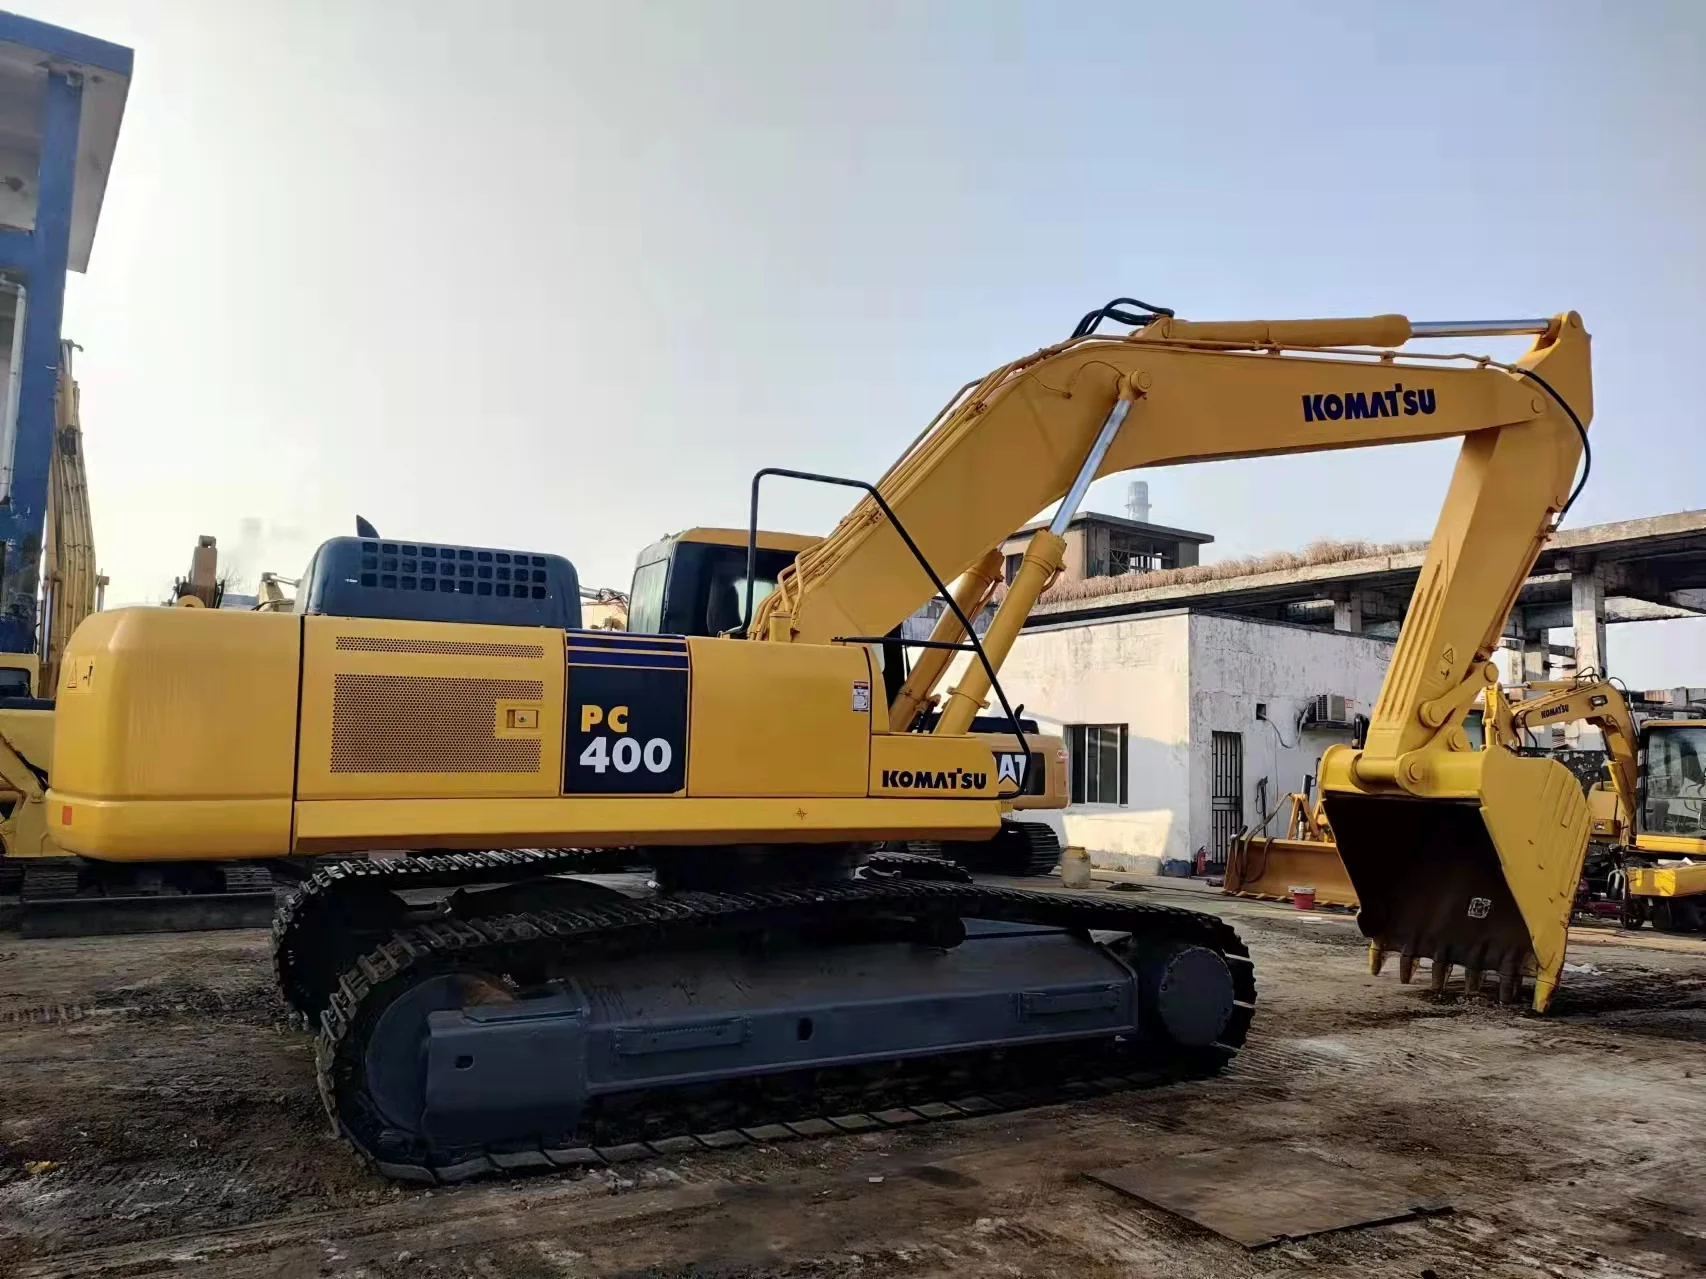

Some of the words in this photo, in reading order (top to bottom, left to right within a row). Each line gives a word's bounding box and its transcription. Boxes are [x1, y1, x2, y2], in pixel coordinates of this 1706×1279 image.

[1302, 383, 1436, 422] KOMATSU
[581, 704, 629, 733] PC
[1541, 704, 1569, 719] KOMATSU
[580, 736, 672, 773] 400
[882, 768, 987, 790] KOMATSU
[997, 754, 1027, 787] AT
